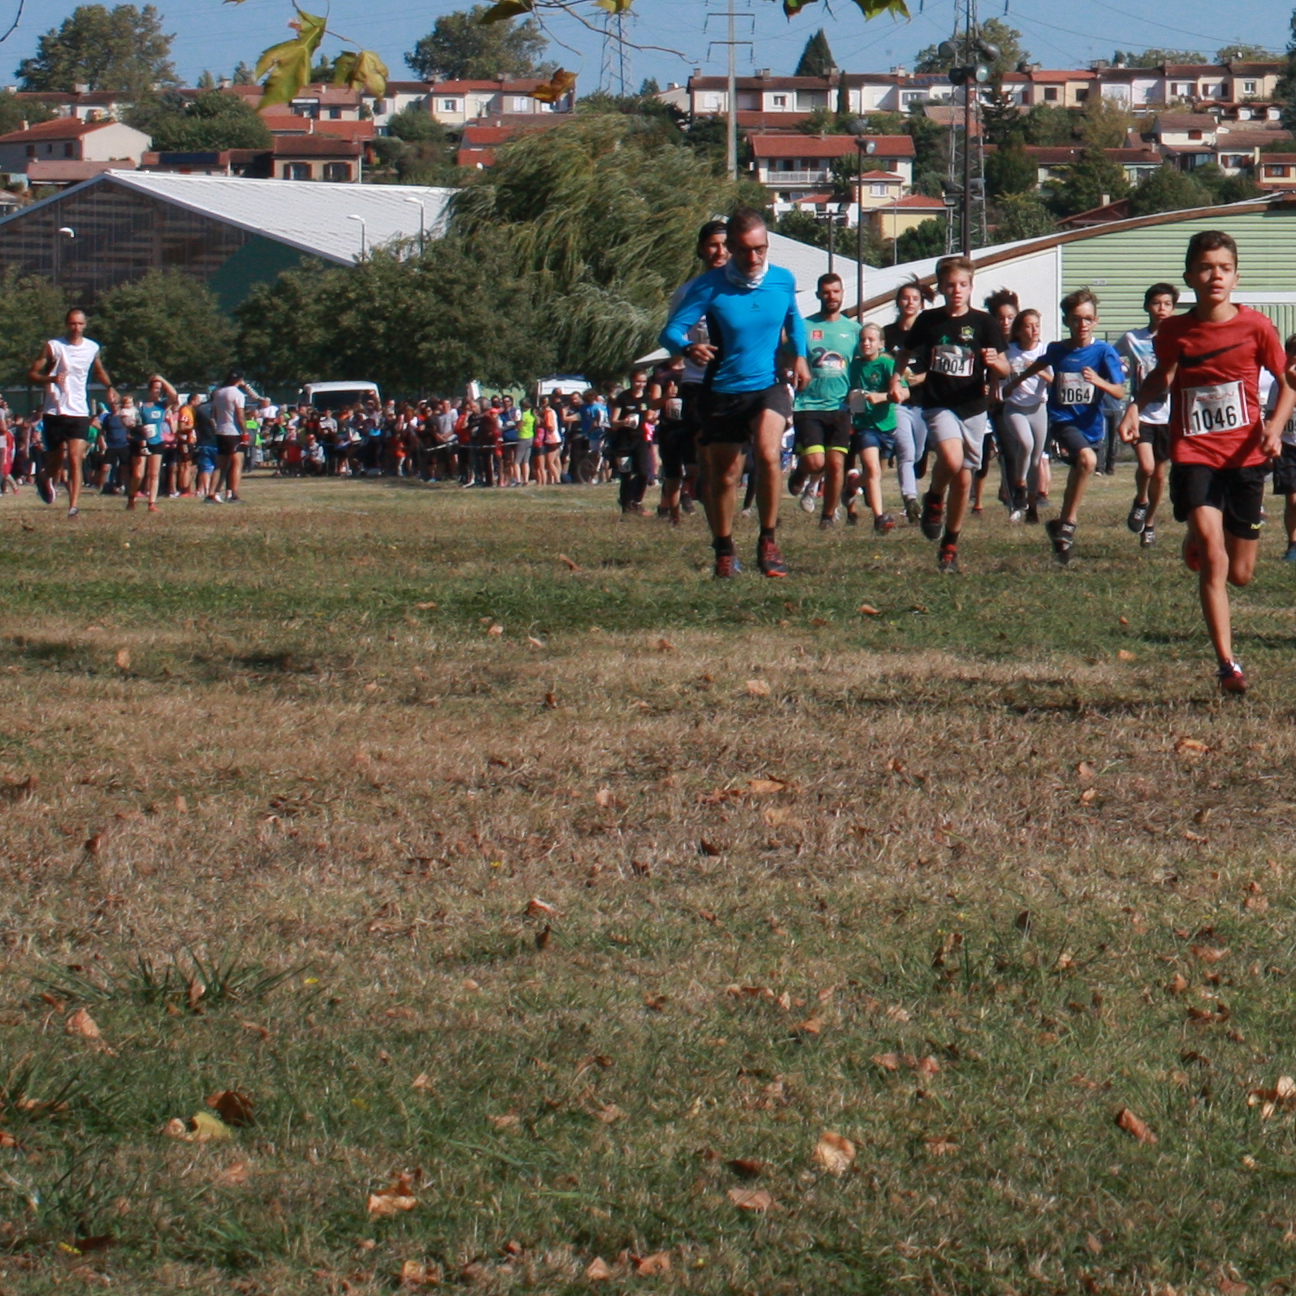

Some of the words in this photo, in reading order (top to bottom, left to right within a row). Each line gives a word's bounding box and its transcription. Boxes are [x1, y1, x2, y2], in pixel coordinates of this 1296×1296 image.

[939, 356, 965, 374] 1004
[1062, 388, 1091, 403] 1064
[1193, 405, 1237, 431] 1046
